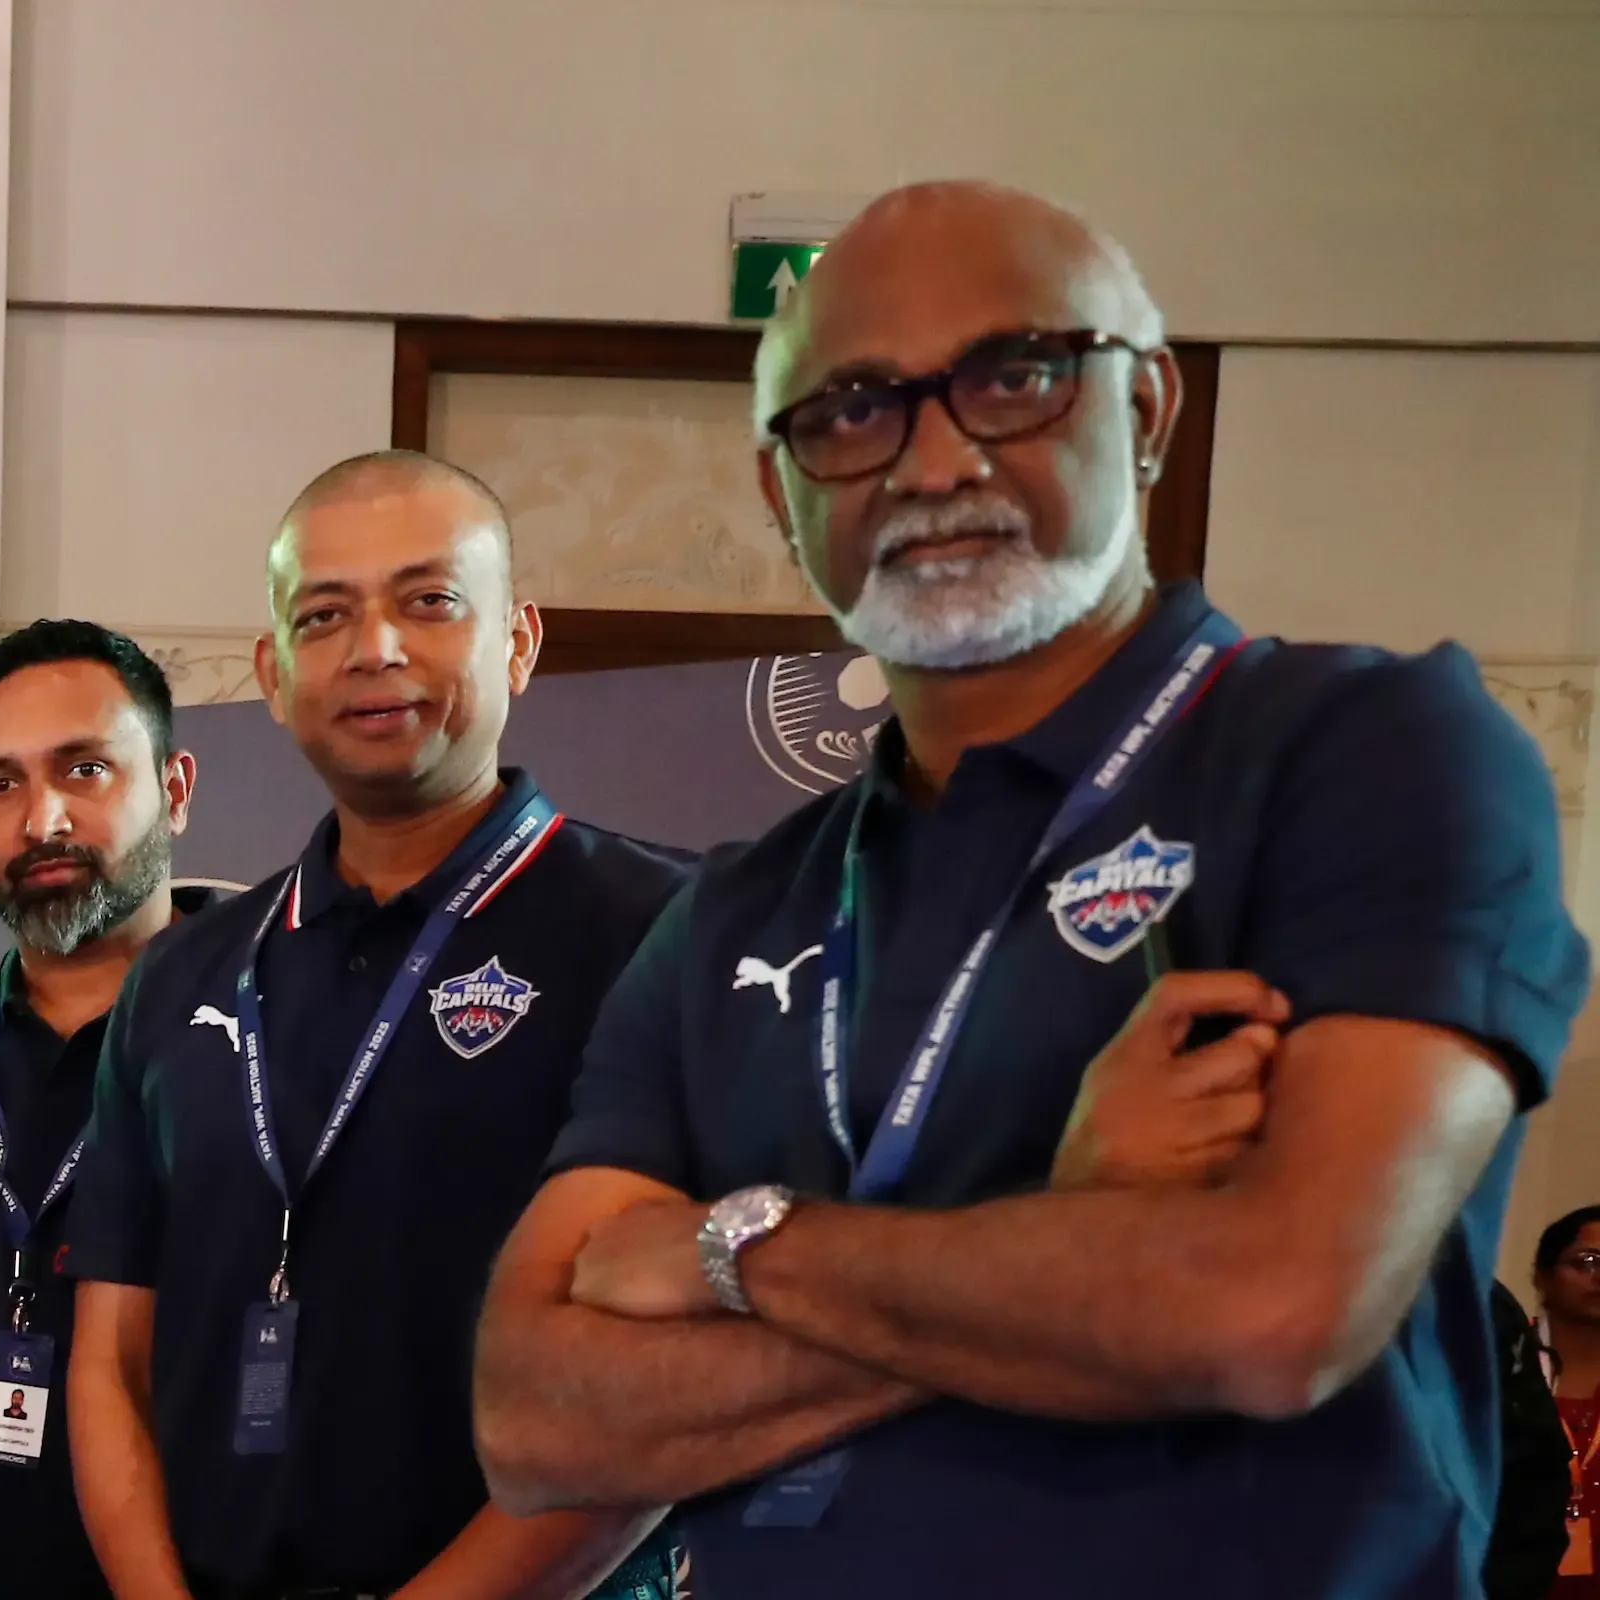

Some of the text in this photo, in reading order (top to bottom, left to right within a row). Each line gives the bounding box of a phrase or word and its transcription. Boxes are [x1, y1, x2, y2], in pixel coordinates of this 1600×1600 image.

[1093, 752, 1130, 789] TATA
[445, 816, 538, 913] TATA WPL AUCTION 2025
[436, 992, 526, 1013] CAPITALS
[464, 982, 507, 995] DELHI
[246, 1032, 272, 1161] TATA WPL AUCTION 2025
[318, 1021, 390, 1157] TATA WPL AUCTION 2025
[892, 1083, 923, 1126] TATA
[57, 1160, 76, 1186] WPL
